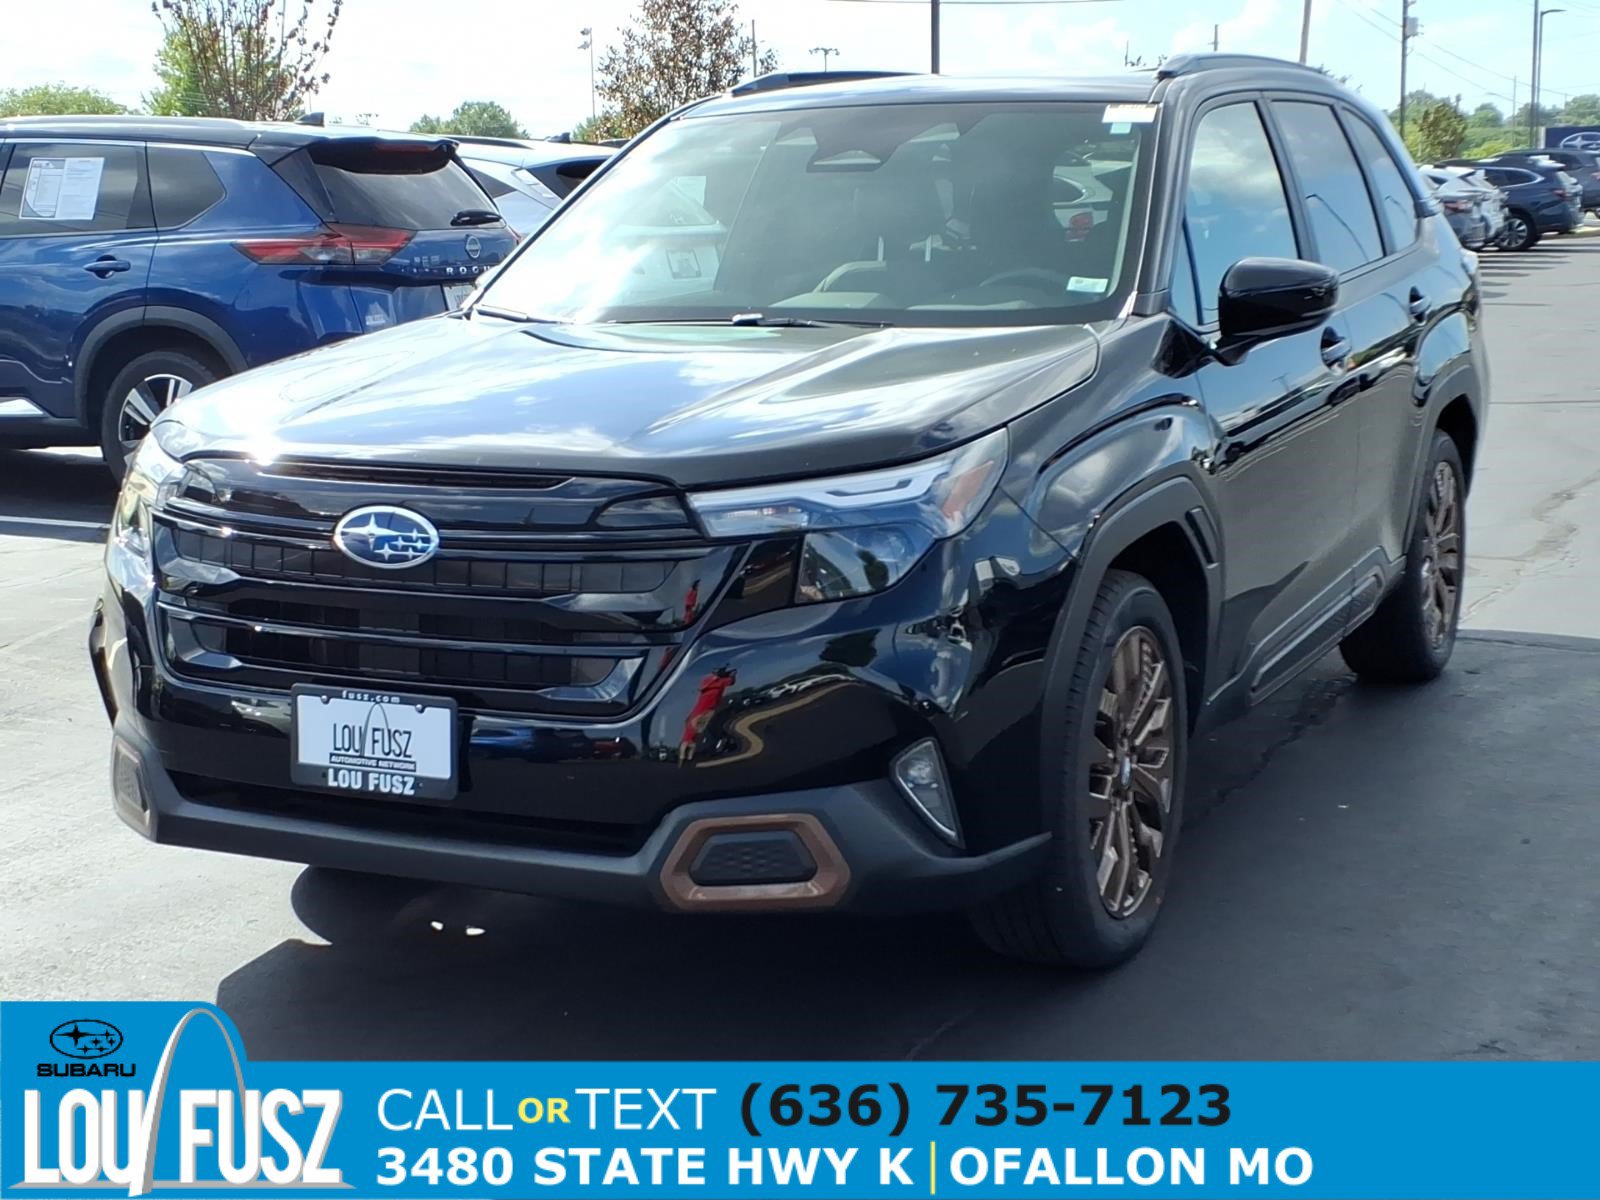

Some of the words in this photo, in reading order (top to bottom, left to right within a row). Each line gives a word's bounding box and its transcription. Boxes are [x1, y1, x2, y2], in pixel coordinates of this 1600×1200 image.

[342, 690, 400, 703] fusz.com
[333, 723, 362, 753] LOU
[371, 727, 412, 758] FUSZ
[328, 768, 362, 789] LOU
[368, 772, 415, 796] FUSZ
